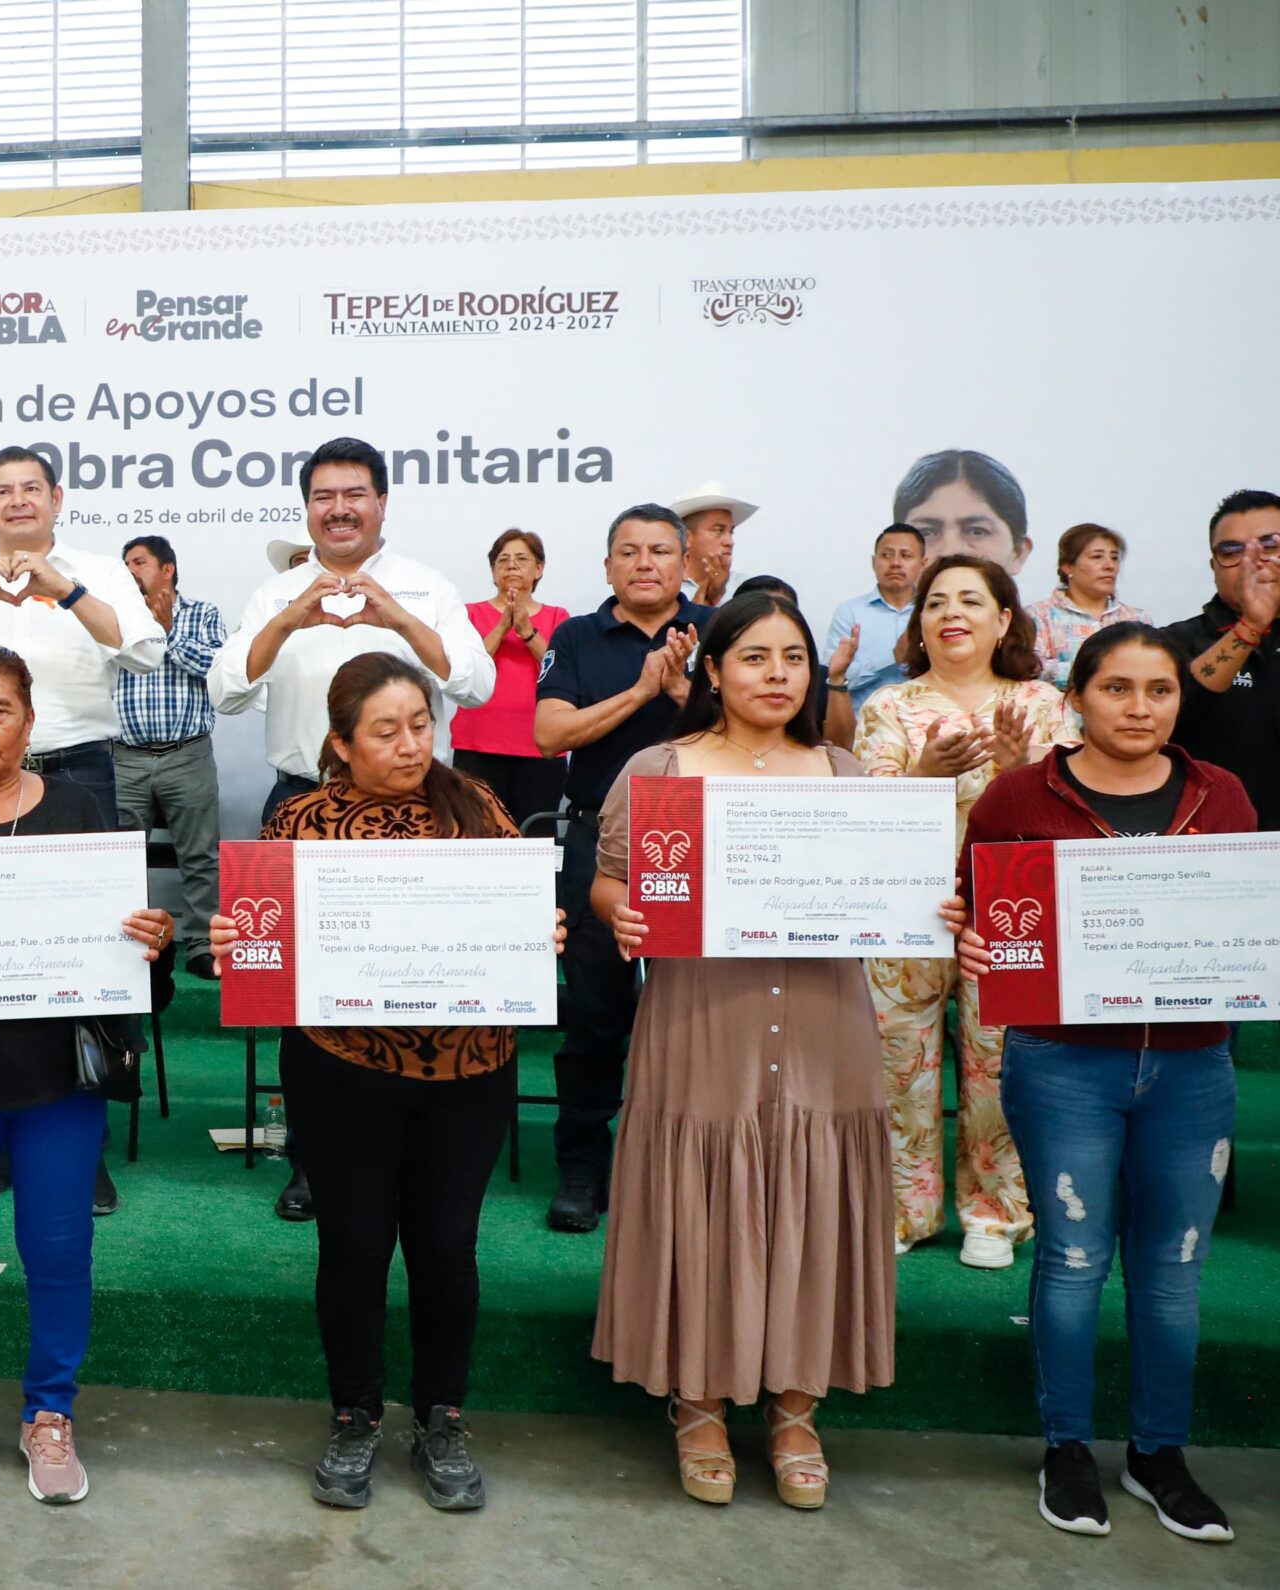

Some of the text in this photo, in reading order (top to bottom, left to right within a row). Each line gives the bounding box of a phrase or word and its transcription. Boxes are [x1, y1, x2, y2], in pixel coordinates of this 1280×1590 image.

[691, 277, 816, 293] TRANSFORMANDO
[136, 289, 249, 317] Pensar
[432, 298, 455, 313] DE
[458, 286, 619, 316] RODRÍGUEZ
[721, 292, 781, 308] TEPEXI
[106, 312, 263, 342] en Grande
[358, 318, 500, 335] AYUNTAMIENTO
[508, 314, 614, 332] 2024-2027
[16, 383, 77, 424] de
[87, 381, 276, 431] Apoyos
[288, 376, 364, 417] del
[70, 510, 112, 527] Pue.,
[116, 513, 129, 525] a
[132, 509, 154, 524] 25
[158, 508, 182, 524] de
[186, 507, 226, 523] abril
[230, 507, 254, 523] de
[258, 507, 302, 523] 2025
[726, 809, 848, 818] Florencia Gervacio Soriano
[726, 853, 782, 864] $592,194.21
[318, 875, 351, 884] Marisol
[353, 875, 375, 884] Soto
[640, 872, 690, 881] PROGRAMA
[726, 876, 757, 887] Tepexi
[759, 876, 771, 885] de
[850, 878, 857, 886] a
[859, 877, 870, 886] 25
[872, 876, 884, 886] de
[886, 876, 907, 886] abril
[909, 876, 922, 886] de
[924, 876, 947, 886] 2025
[1080, 870, 1211, 883] Berenice Camargo Sevilla
[640, 881, 691, 895] OBRA
[319, 919, 370, 931] $33,108.13
[1082, 917, 1144, 929] $33,069.00
[741, 931, 778, 939] PUEBLA
[788, 932, 839, 942] Bienestar
[320, 943, 351, 954] Tepexi
[354, 943, 366, 952] de
[456, 943, 467, 952] 25
[471, 943, 483, 952] de
[485, 942, 506, 952] abril
[509, 942, 522, 952] de
[524, 942, 548, 951] 2025
[989, 939, 1043, 949] PROGRAMA
[1083, 942, 1117, 952] Tepexi
[1120, 941, 1133, 950] de
[1222, 939, 1230, 948] a
[1232, 937, 1245, 947] 25
[1247, 937, 1262, 947] de
[231, 947, 283, 963] OBRA
[990, 948, 1044, 963] OBRA
[231, 962, 283, 970] COMUNITARIA
[990, 962, 1044, 971] COMUNITARIA
[335, 999, 373, 1007] PUEBLA
[384, 999, 437, 1009] Bienestar
[1102, 996, 1143, 1005] PUEBLA
[1155, 995, 1212, 1006] Bienestar
